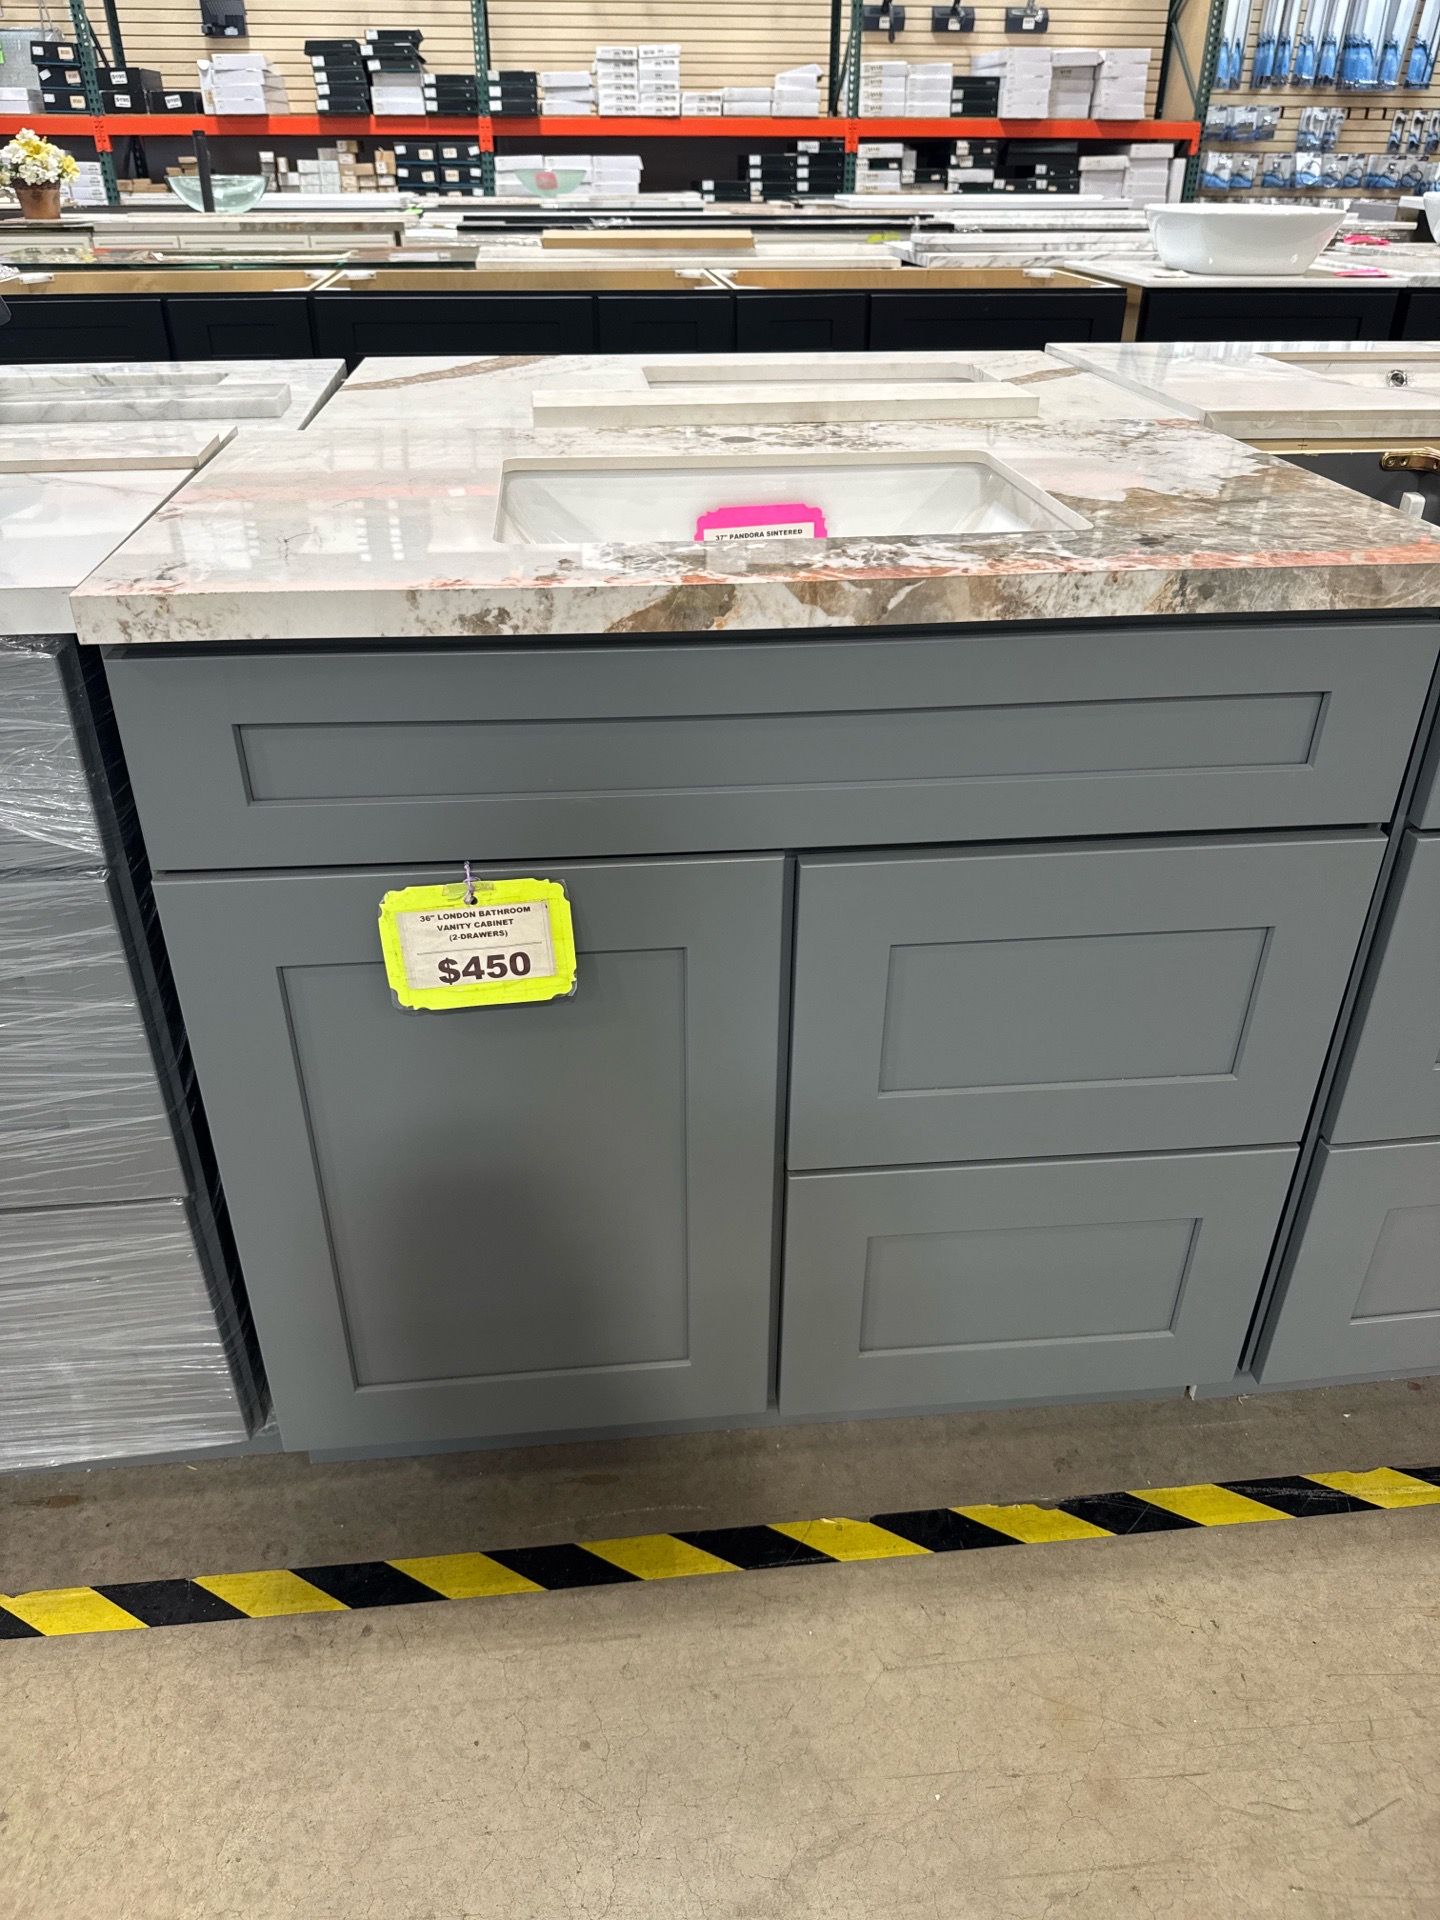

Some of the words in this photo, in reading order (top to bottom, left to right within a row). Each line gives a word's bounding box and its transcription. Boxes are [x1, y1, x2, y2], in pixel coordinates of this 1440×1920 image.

[729, 531, 765, 540] PANDORA
[766, 528, 803, 537] SINTERED
[419, 914, 435, 923] 36"
[437, 910, 476, 921] LONDON
[478, 905, 531, 917] BATHROOM
[437, 922, 471, 932] VANITY
[474, 918, 514, 928] CABINET
[449, 930, 509, 942] (2-DRAWERS)
[437, 951, 531, 985] $450
